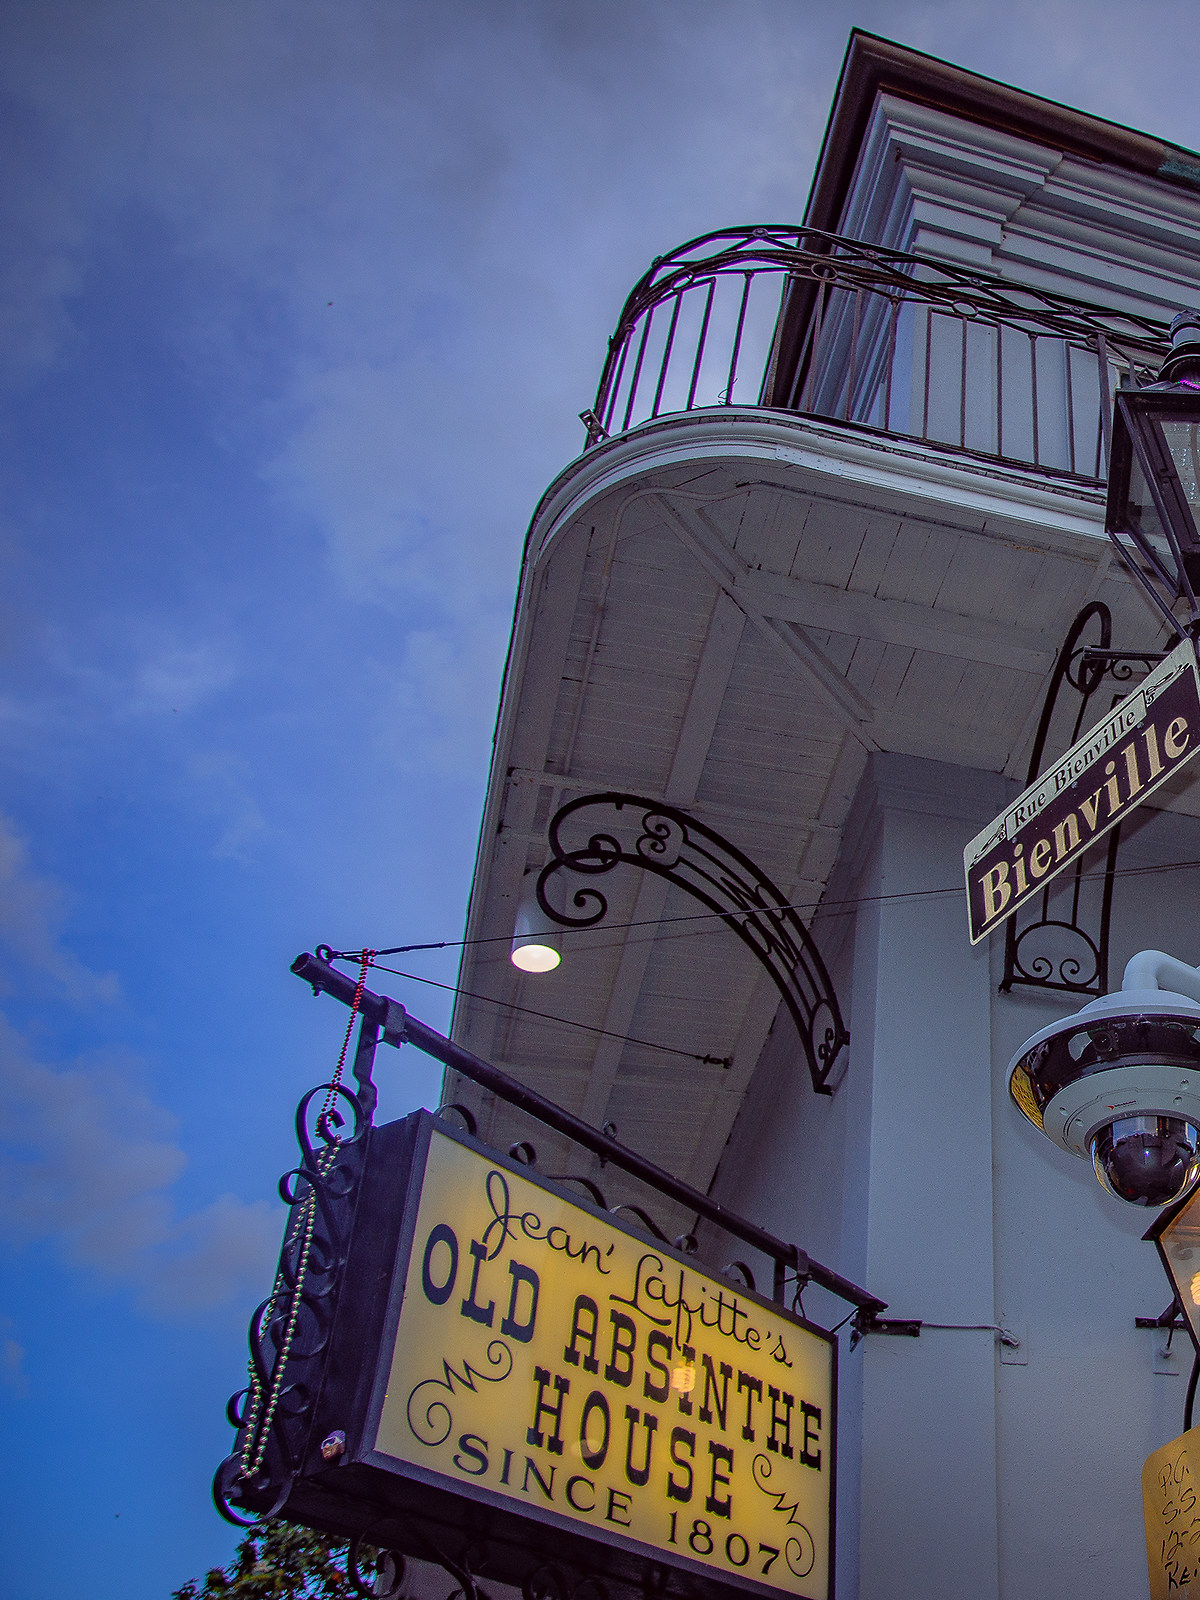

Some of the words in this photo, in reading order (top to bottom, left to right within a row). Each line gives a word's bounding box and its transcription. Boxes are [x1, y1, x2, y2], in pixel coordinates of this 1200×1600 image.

[977, 716, 1191, 929] Bienville
[1011, 794, 1047, 828] Rue
[1053, 708, 1136, 794] Bienville
[422, 1223, 541, 1344] OLD
[563, 1294, 823, 1473] ABSINTHE
[608, 1253, 793, 1368] Lafitte's
[452, 1432, 634, 1528] SINCE
[667, 1511, 781, 1576] 1807
[526, 1366, 735, 1521] HOUSE
